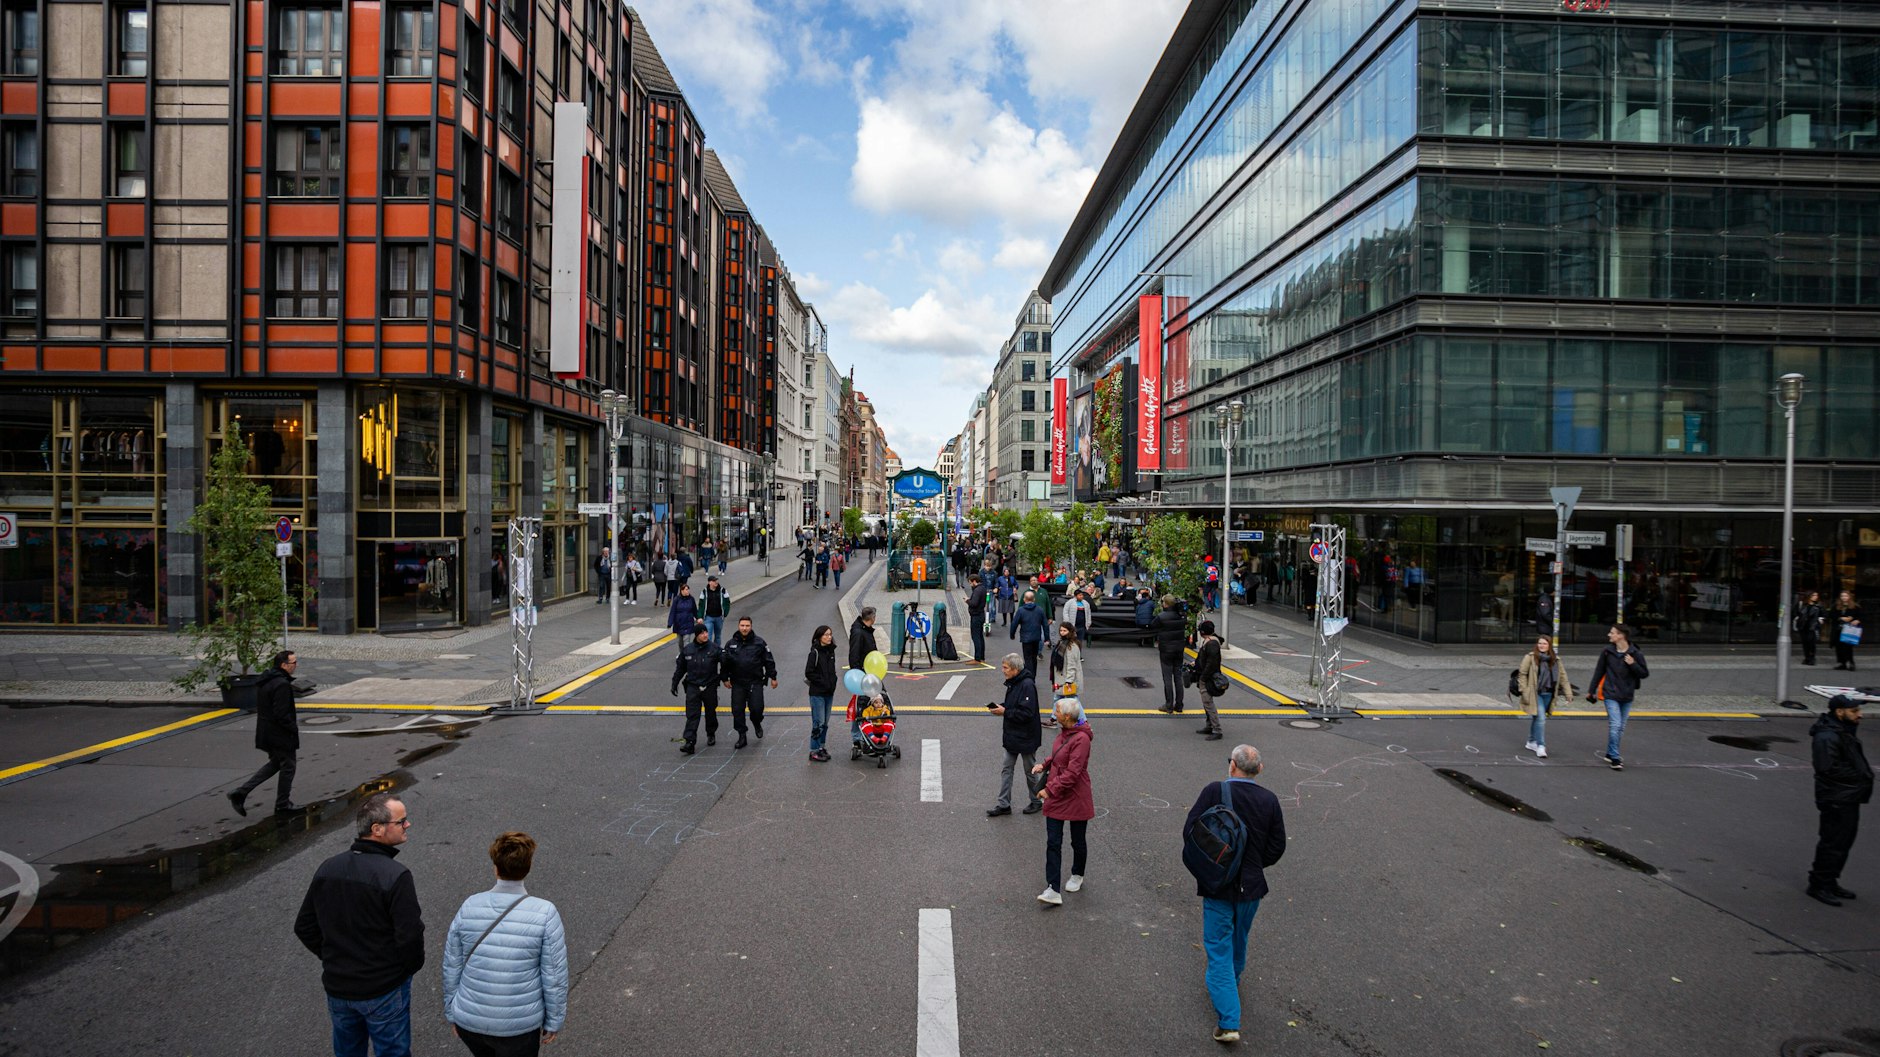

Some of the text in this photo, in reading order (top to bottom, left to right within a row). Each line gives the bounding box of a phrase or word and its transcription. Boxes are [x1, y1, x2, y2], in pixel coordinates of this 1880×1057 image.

[913, 476, 924, 488] U
[1284, 519, 1309, 531] GUCCI
[1569, 534, 1601, 543] Jägerstraße
